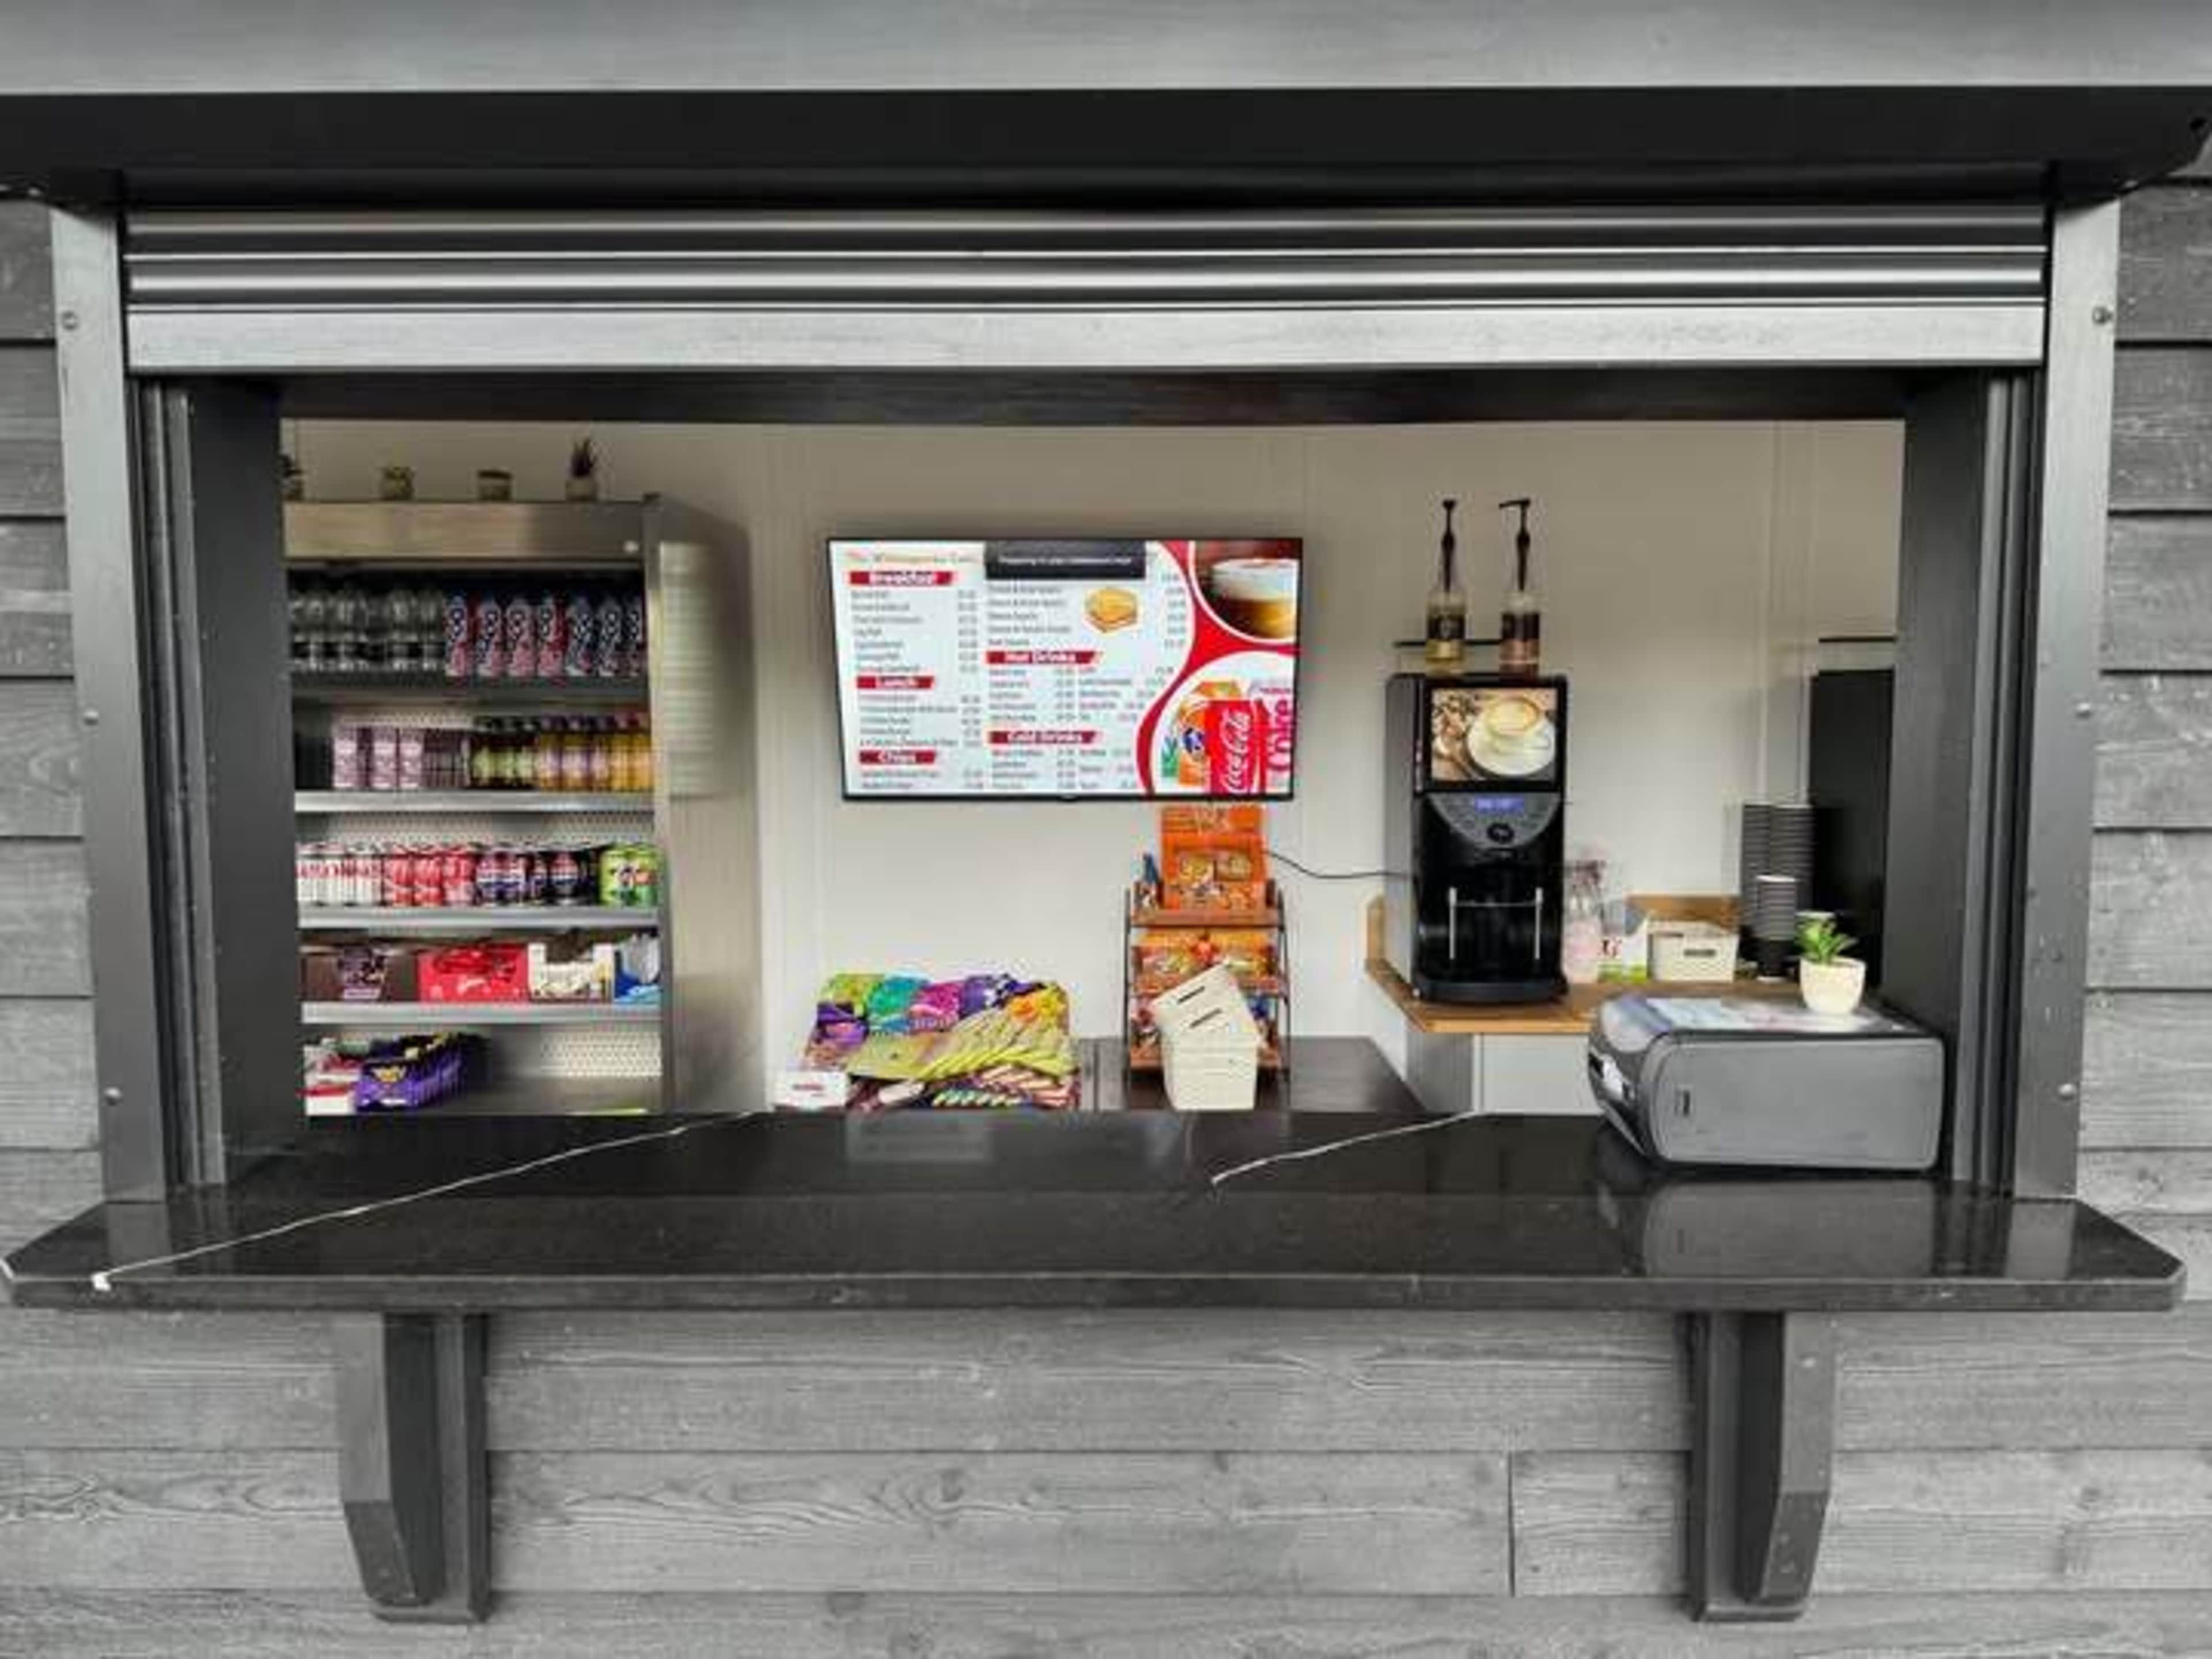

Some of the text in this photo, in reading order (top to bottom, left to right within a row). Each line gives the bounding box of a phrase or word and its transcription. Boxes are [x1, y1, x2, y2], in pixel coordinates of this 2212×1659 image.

[869, 569, 938, 586] Breakfast
[1034, 650, 1076, 664] Drinks
[876, 675, 918, 690] Lunch
[1008, 730, 1081, 744] Cold Drinks
